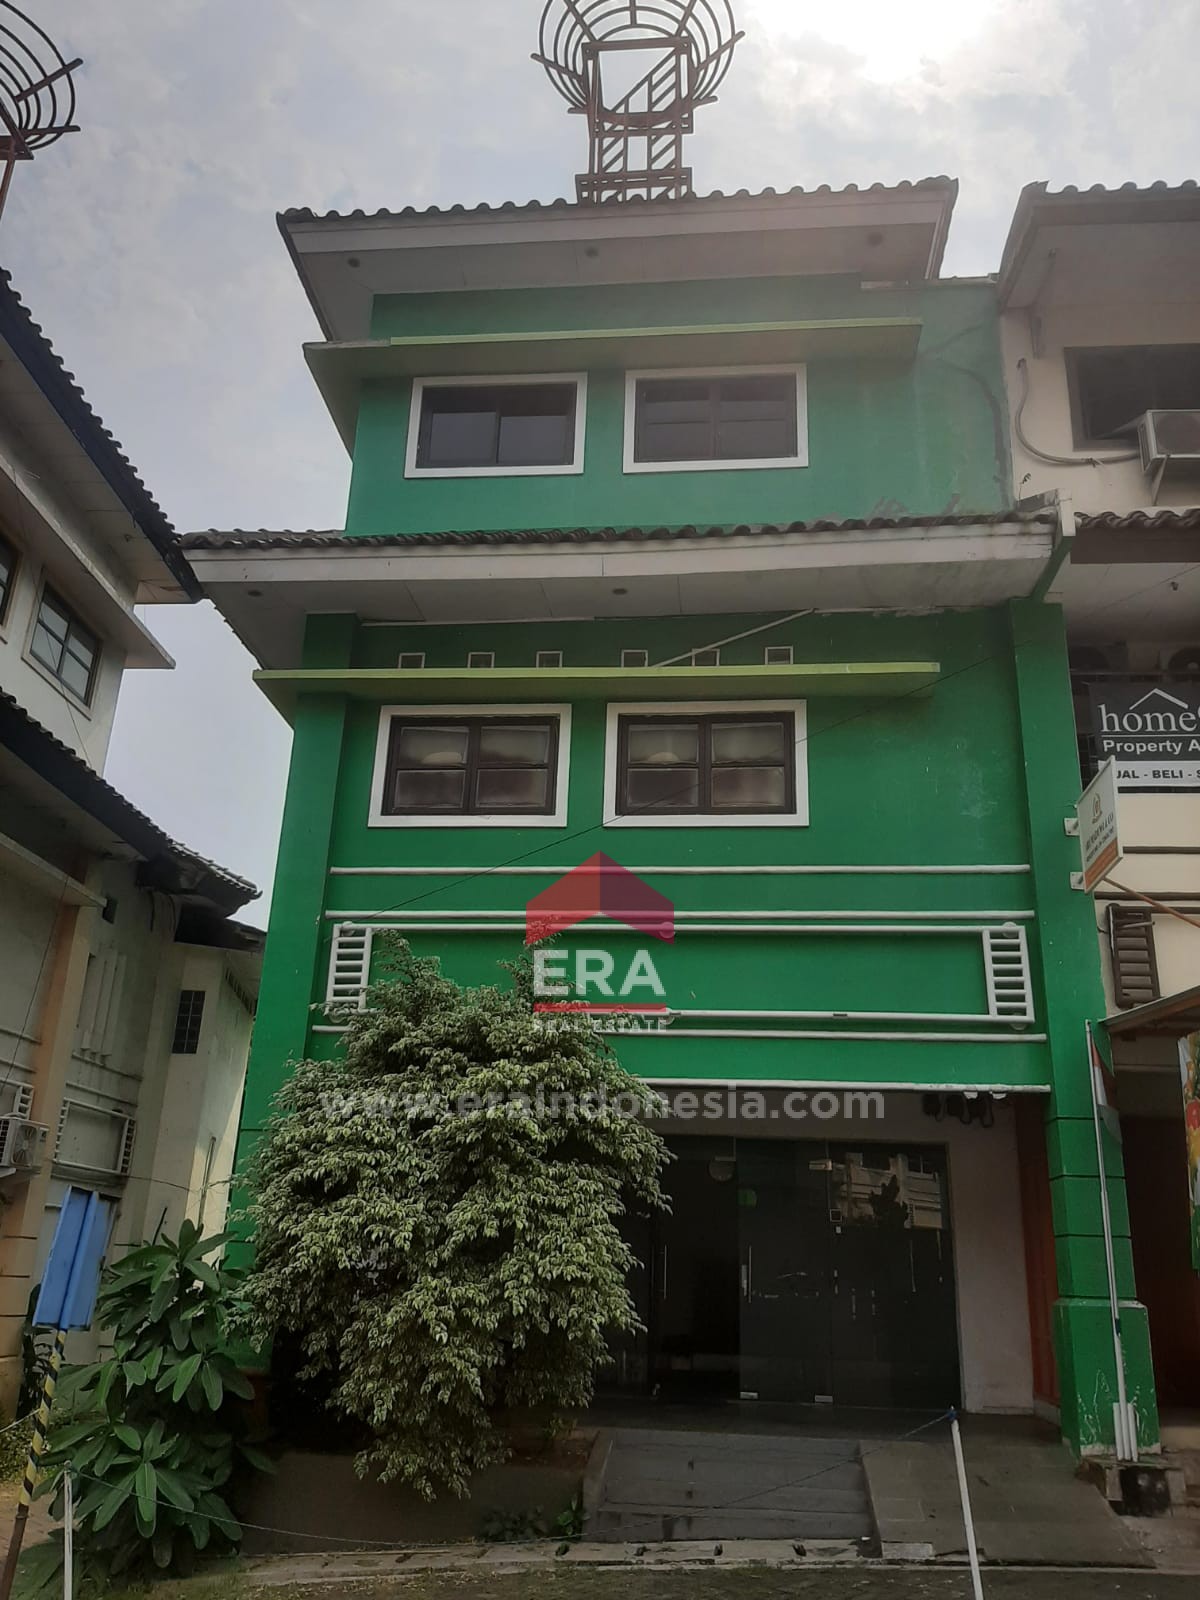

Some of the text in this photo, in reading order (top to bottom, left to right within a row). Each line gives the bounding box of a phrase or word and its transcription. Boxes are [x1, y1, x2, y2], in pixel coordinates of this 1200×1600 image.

[1097, 703, 1200, 732] home
[1103, 739, 1182, 755] Property
[1152, 769, 1184, 779] BELI
